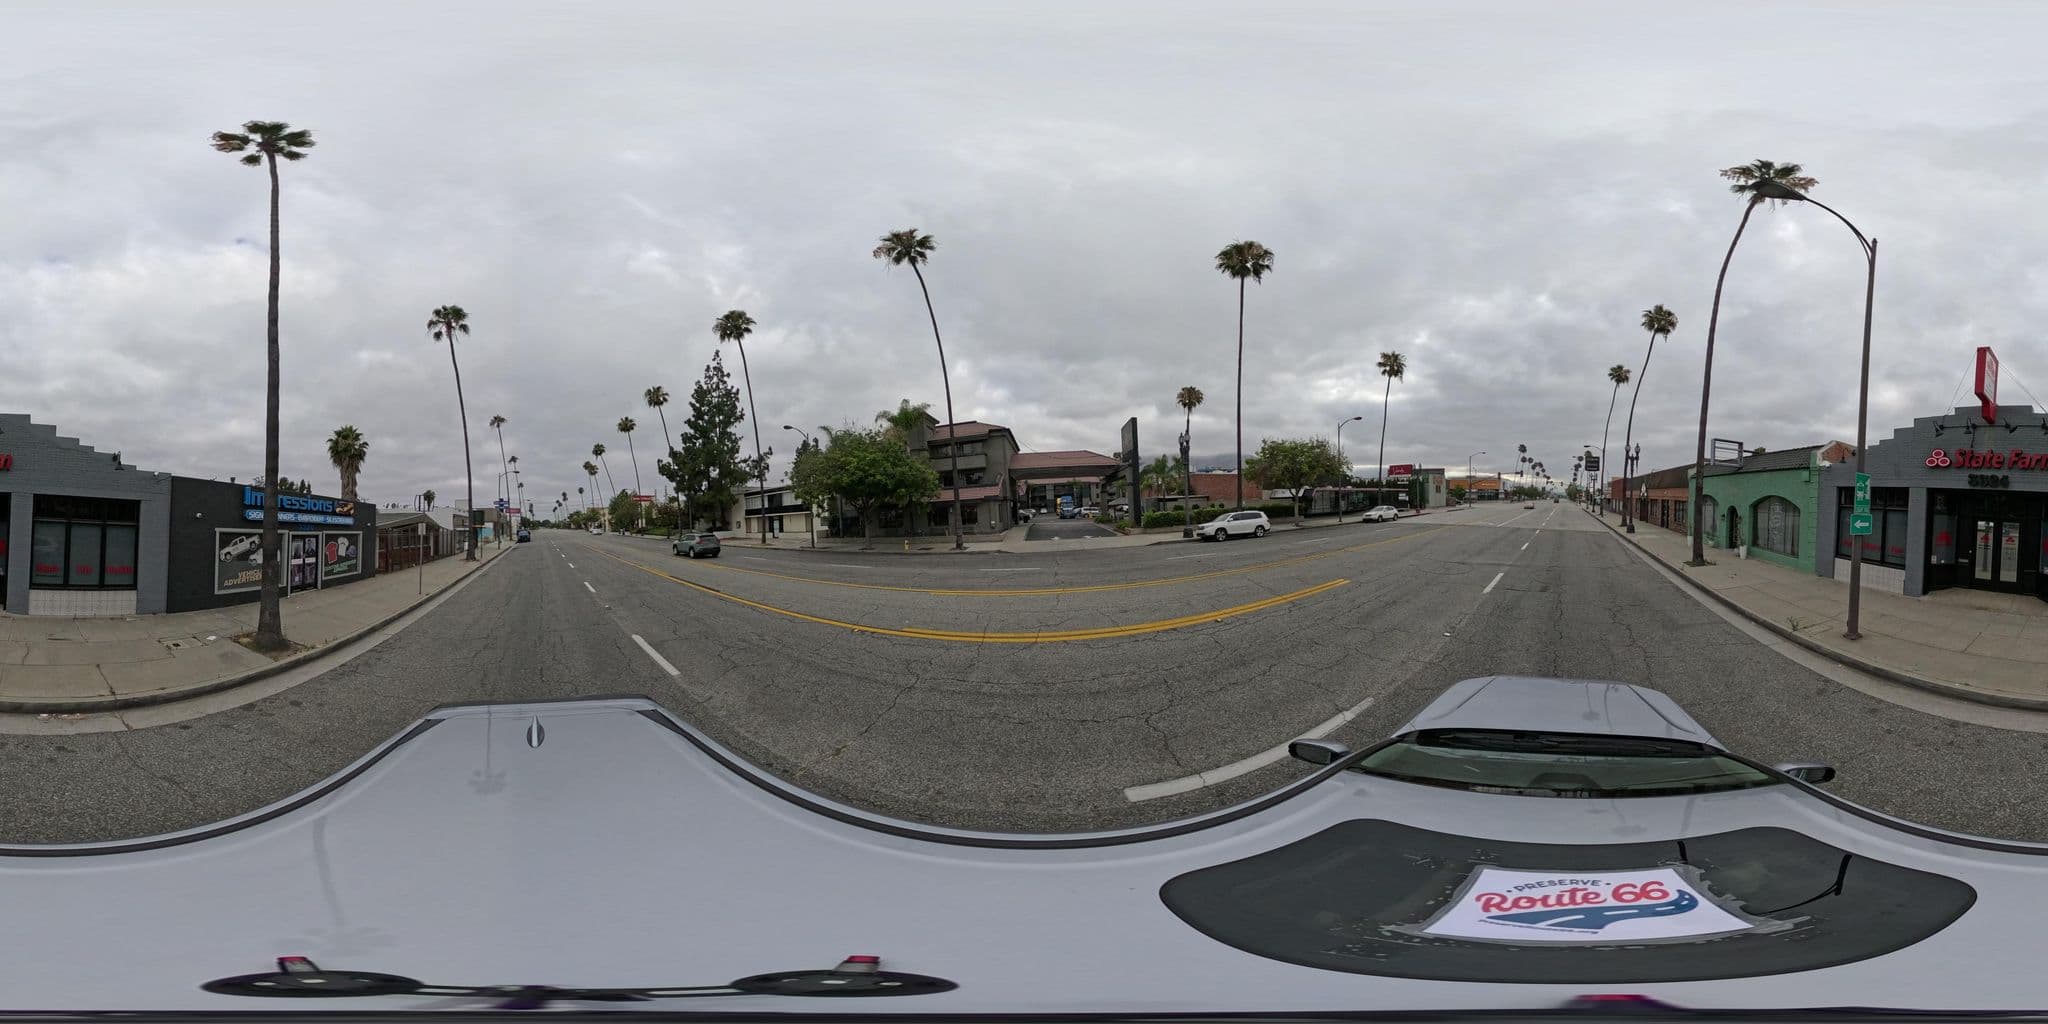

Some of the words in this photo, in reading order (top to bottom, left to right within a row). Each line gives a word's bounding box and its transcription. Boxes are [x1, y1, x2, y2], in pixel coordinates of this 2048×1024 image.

[1952, 448, 2004, 469] State
[244, 486, 333, 512] Imressions
[1475, 887, 1607, 912] Route
[1611, 880, 1670, 903] 66
[1513, 879, 1601, 892] PRESERVE
